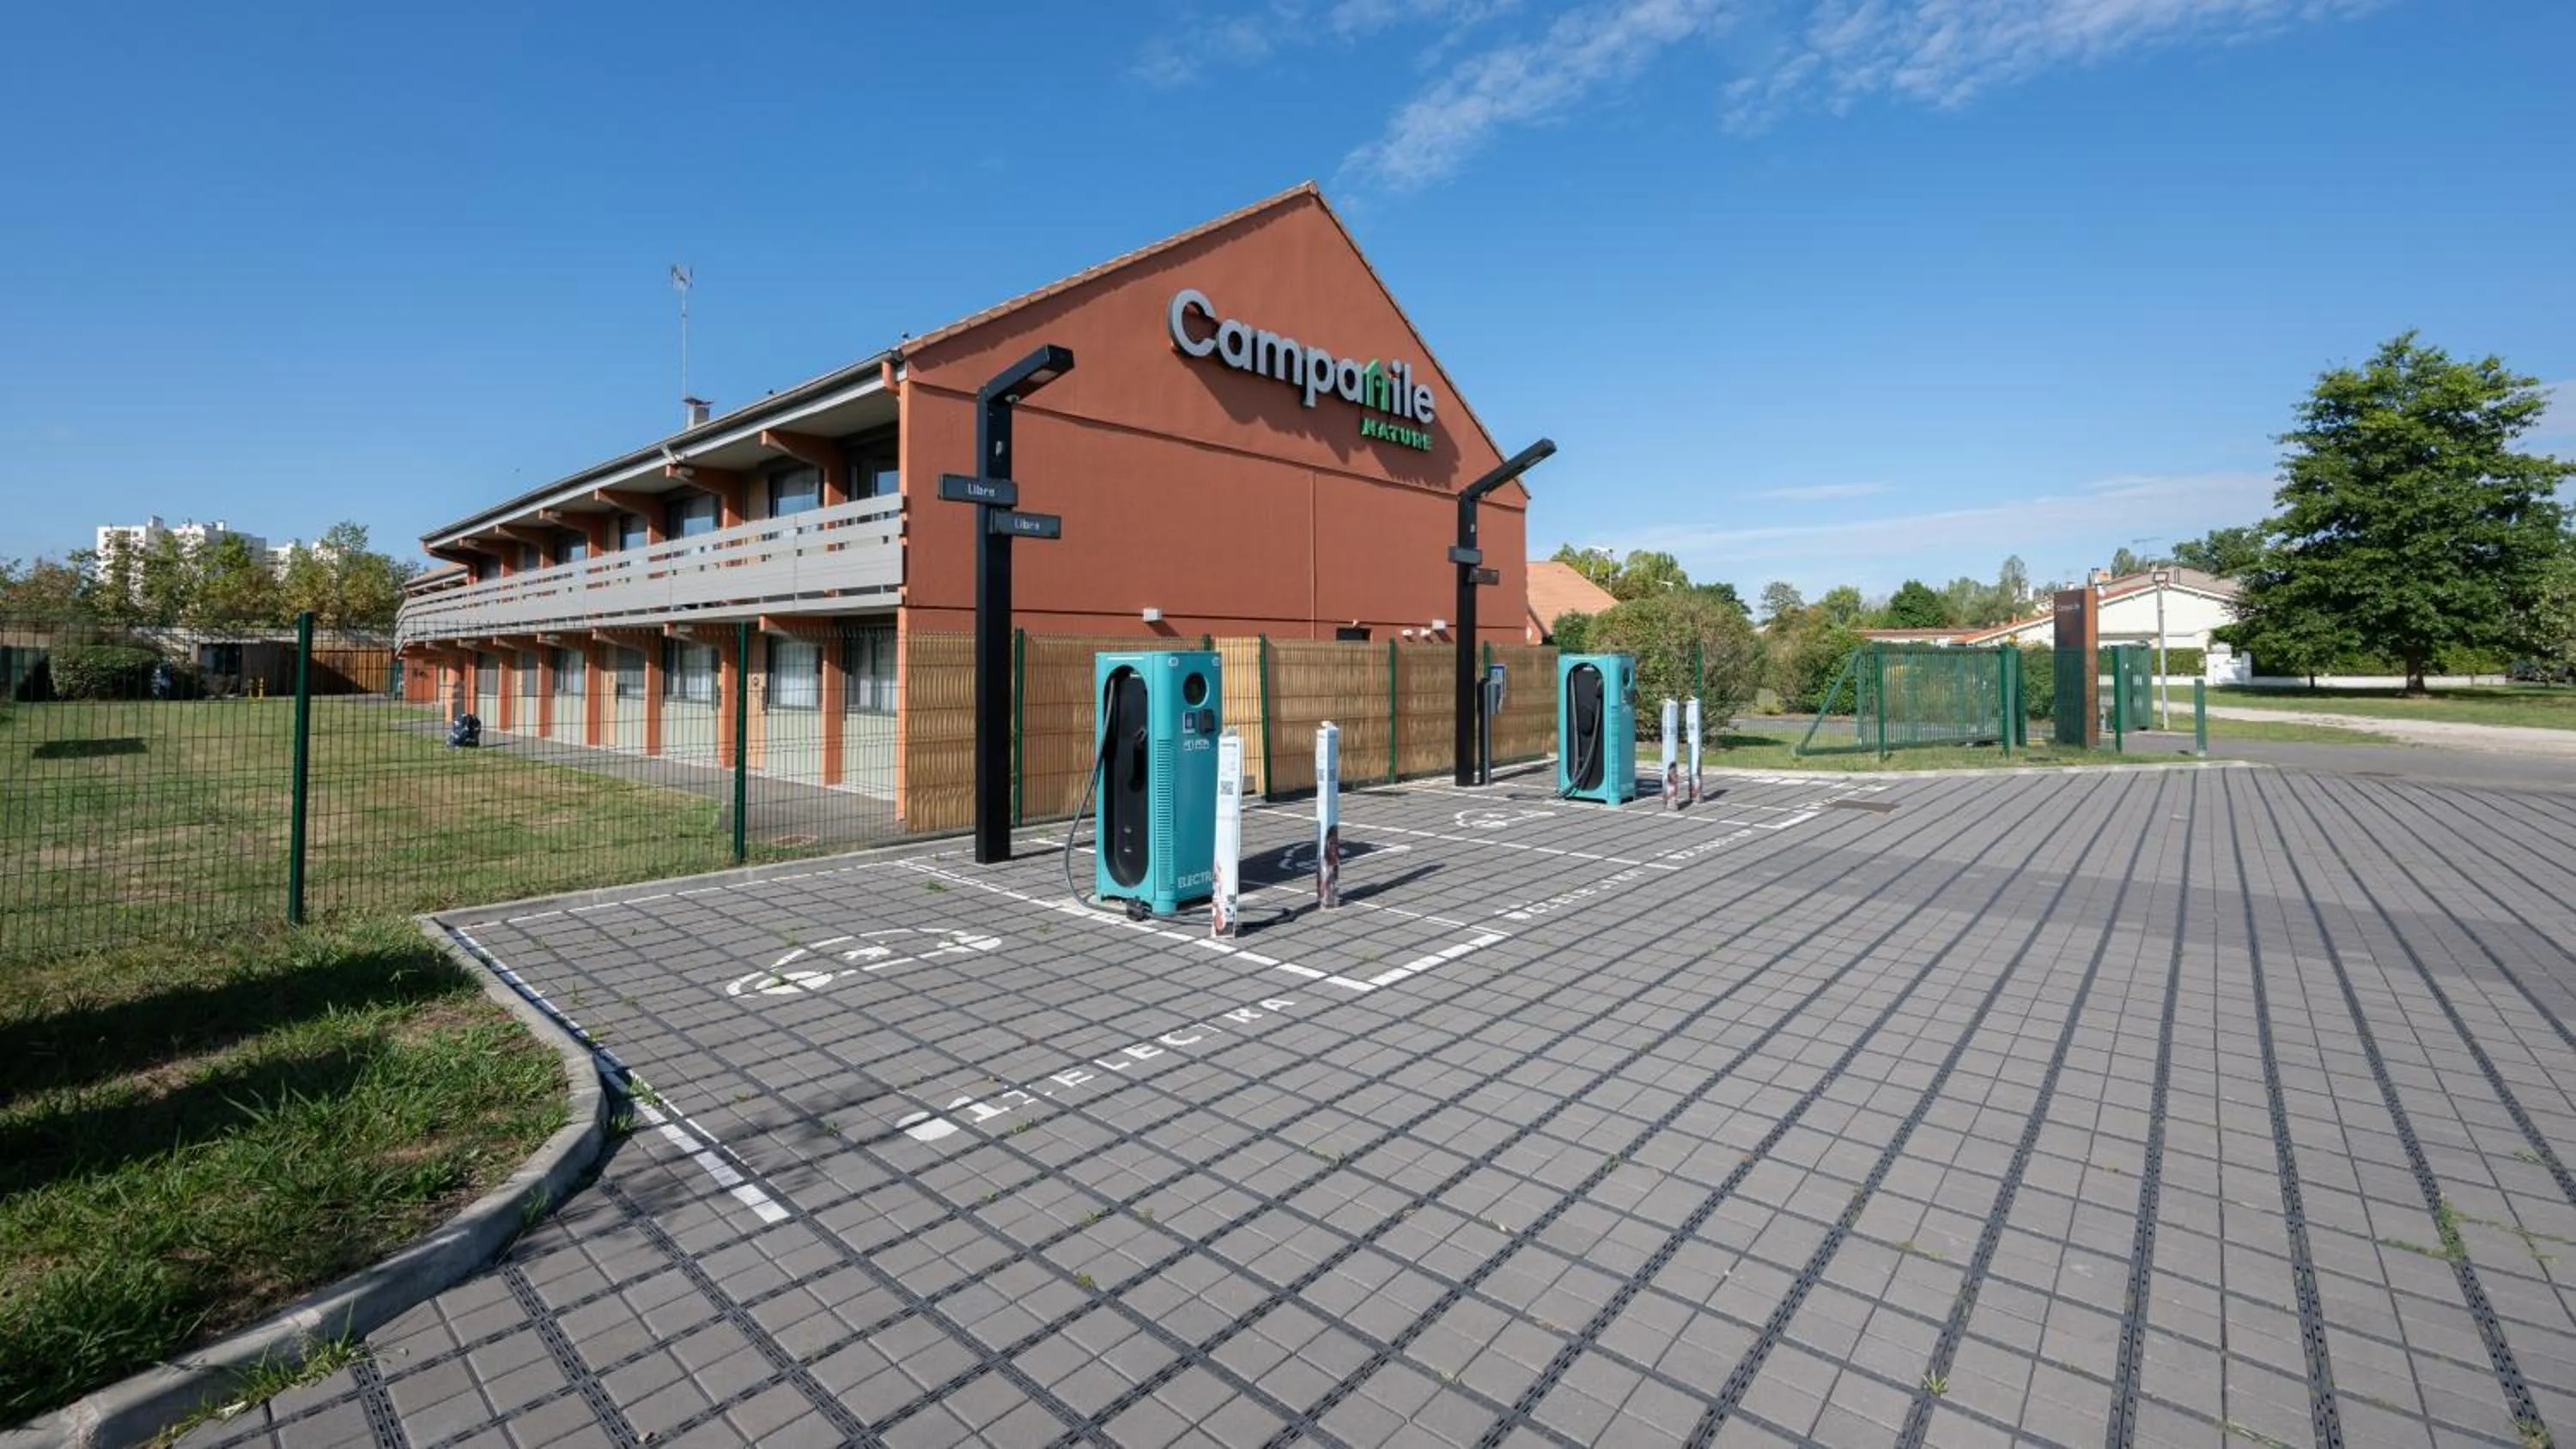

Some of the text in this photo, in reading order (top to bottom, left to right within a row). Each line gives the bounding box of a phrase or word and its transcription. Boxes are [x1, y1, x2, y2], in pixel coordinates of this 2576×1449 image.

[1169, 288, 1436, 423] Campanile
[1361, 417, 1433, 452] NATURE
[967, 483, 995, 496] Libre
[1177, 870, 1214, 888] ELECTR
